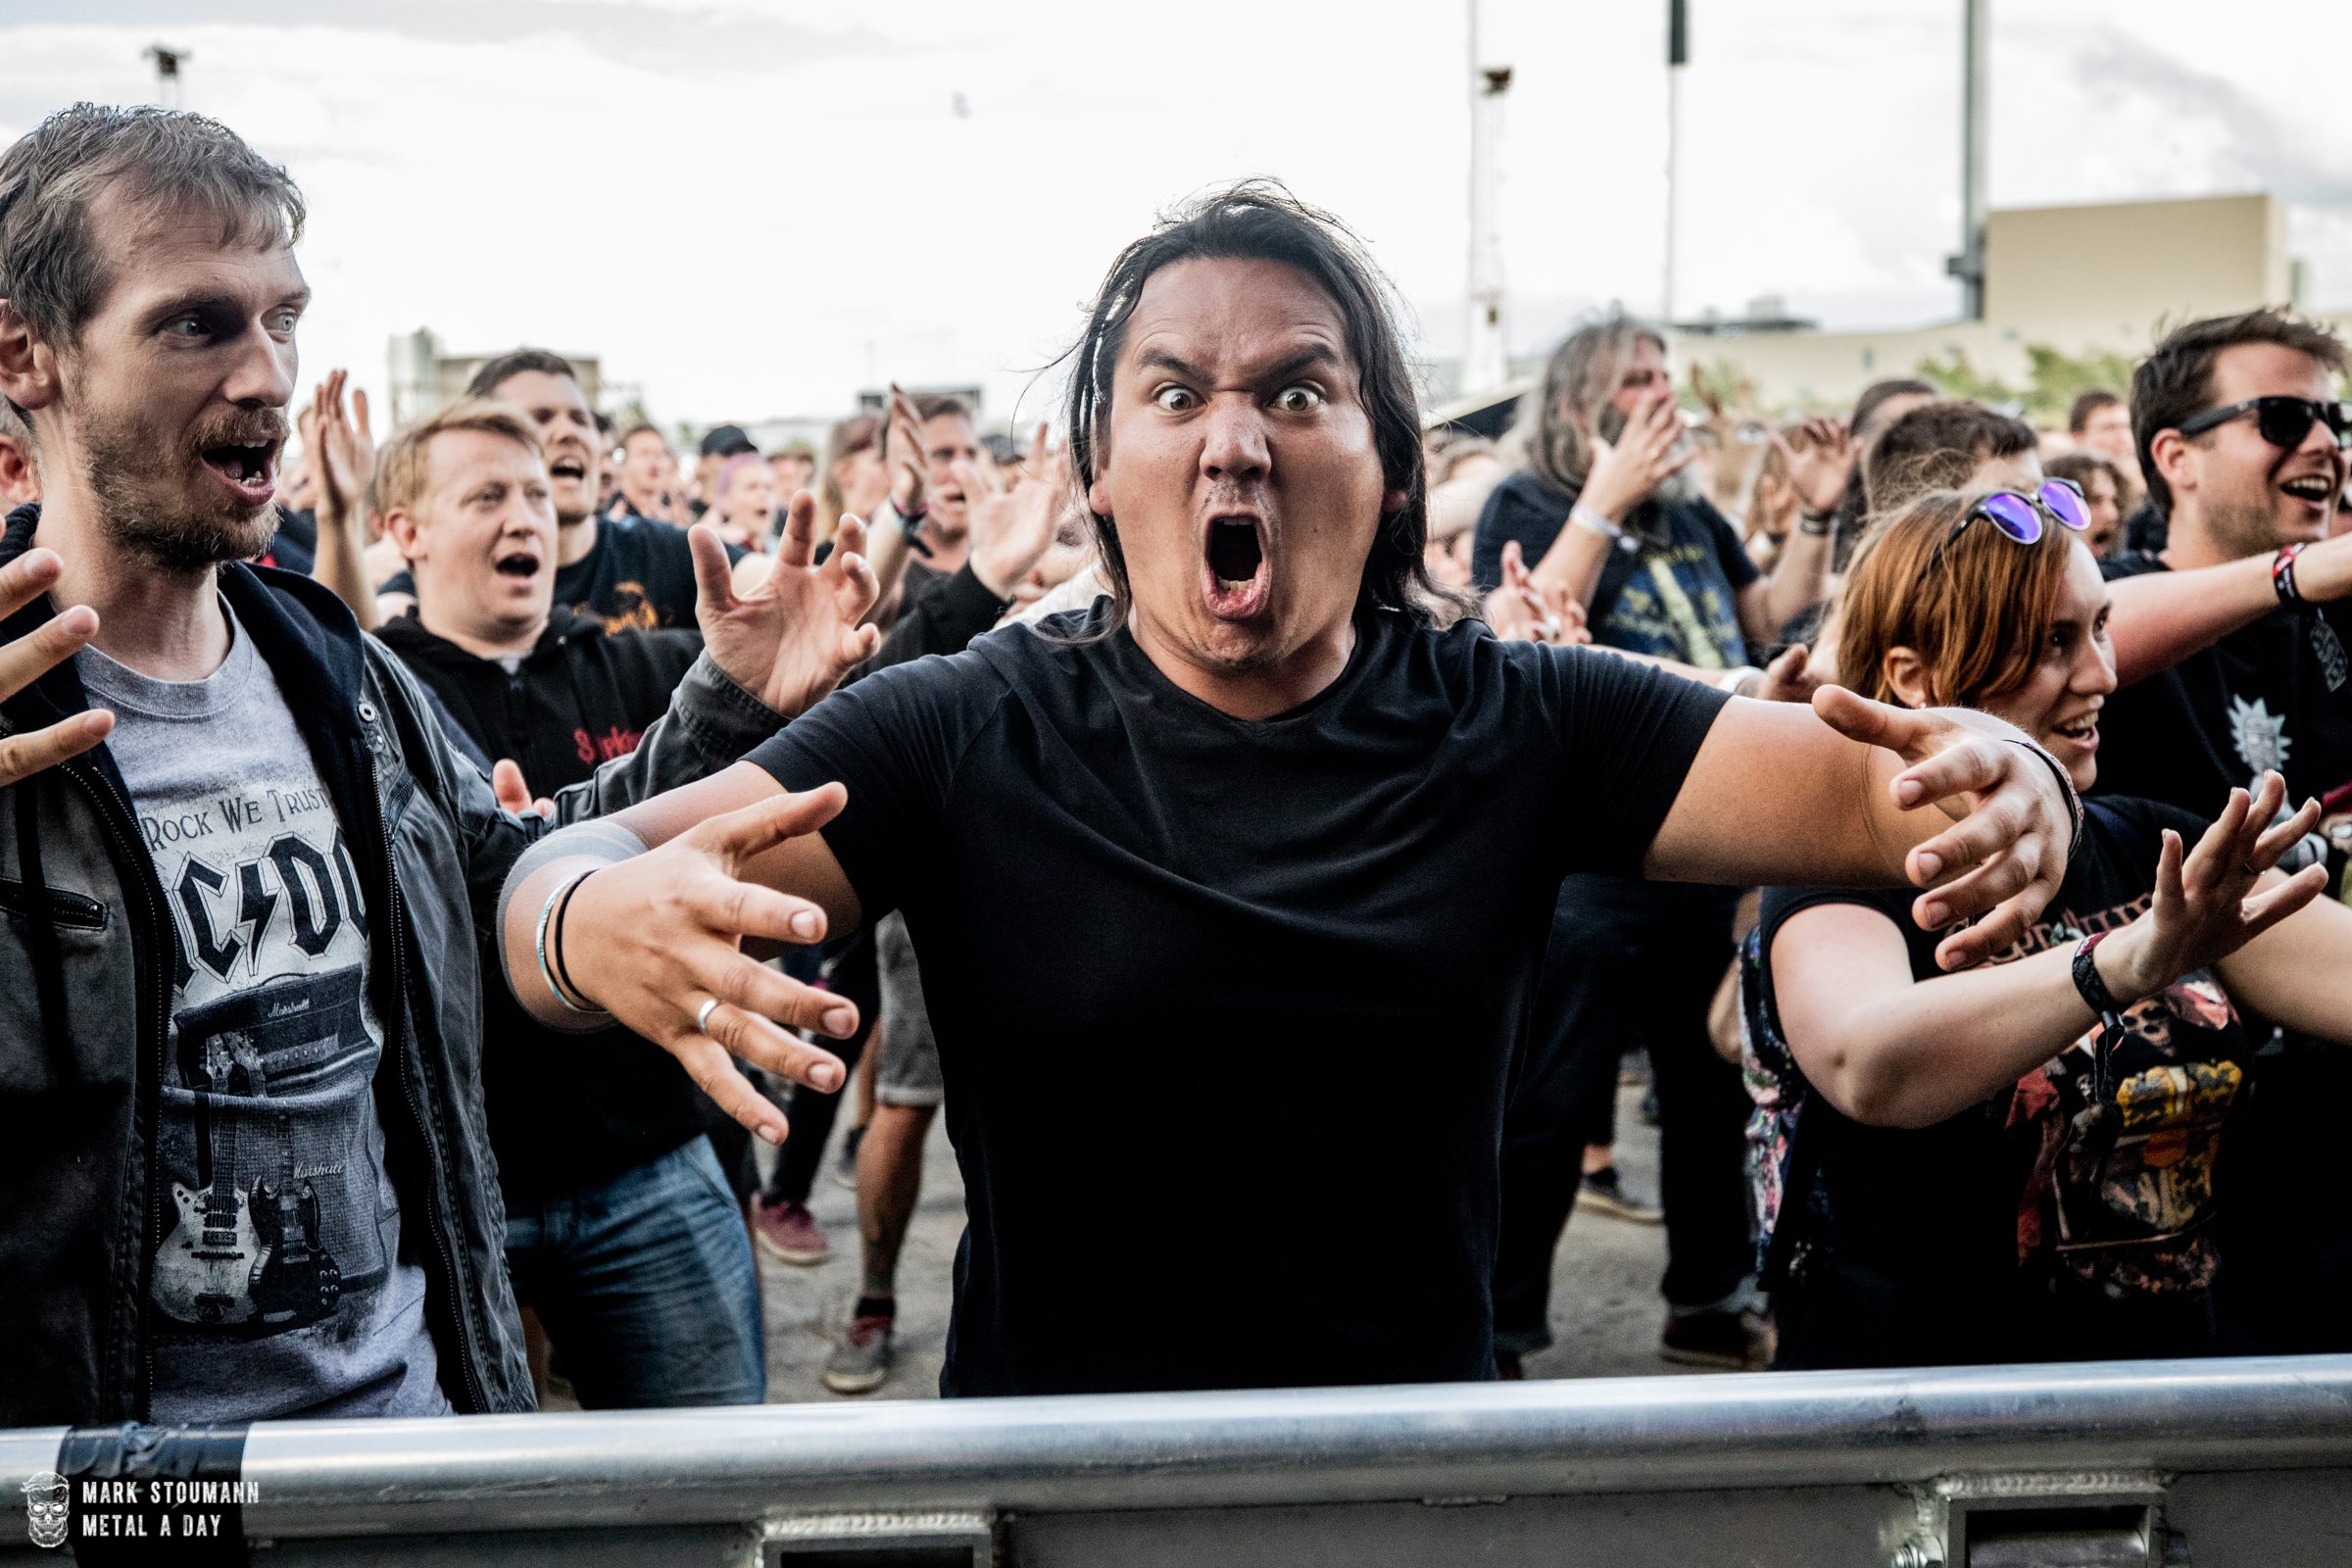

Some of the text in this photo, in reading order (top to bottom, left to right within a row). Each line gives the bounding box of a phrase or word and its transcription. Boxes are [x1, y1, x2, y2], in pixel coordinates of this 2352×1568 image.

[218, 797, 263, 834] WE
[267, 788, 329, 822] TRUST
[294, 1160, 345, 1179] Marshall
